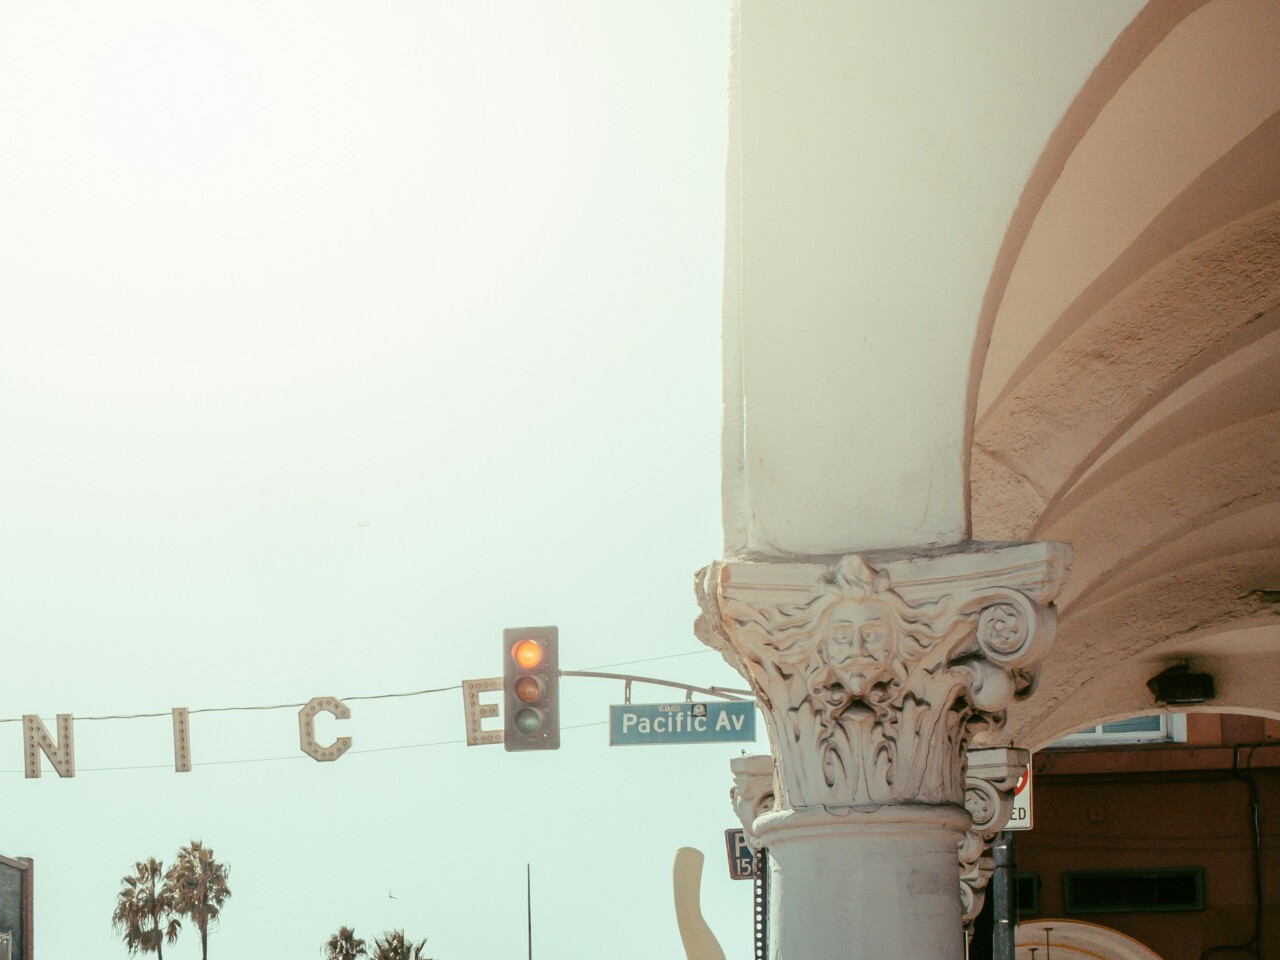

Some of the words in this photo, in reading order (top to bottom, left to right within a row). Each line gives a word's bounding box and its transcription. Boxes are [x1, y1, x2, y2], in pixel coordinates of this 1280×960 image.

[622, 711, 707, 734] Pacific
[715, 710, 745, 732] Av
[1010, 807, 1027, 821] ED
